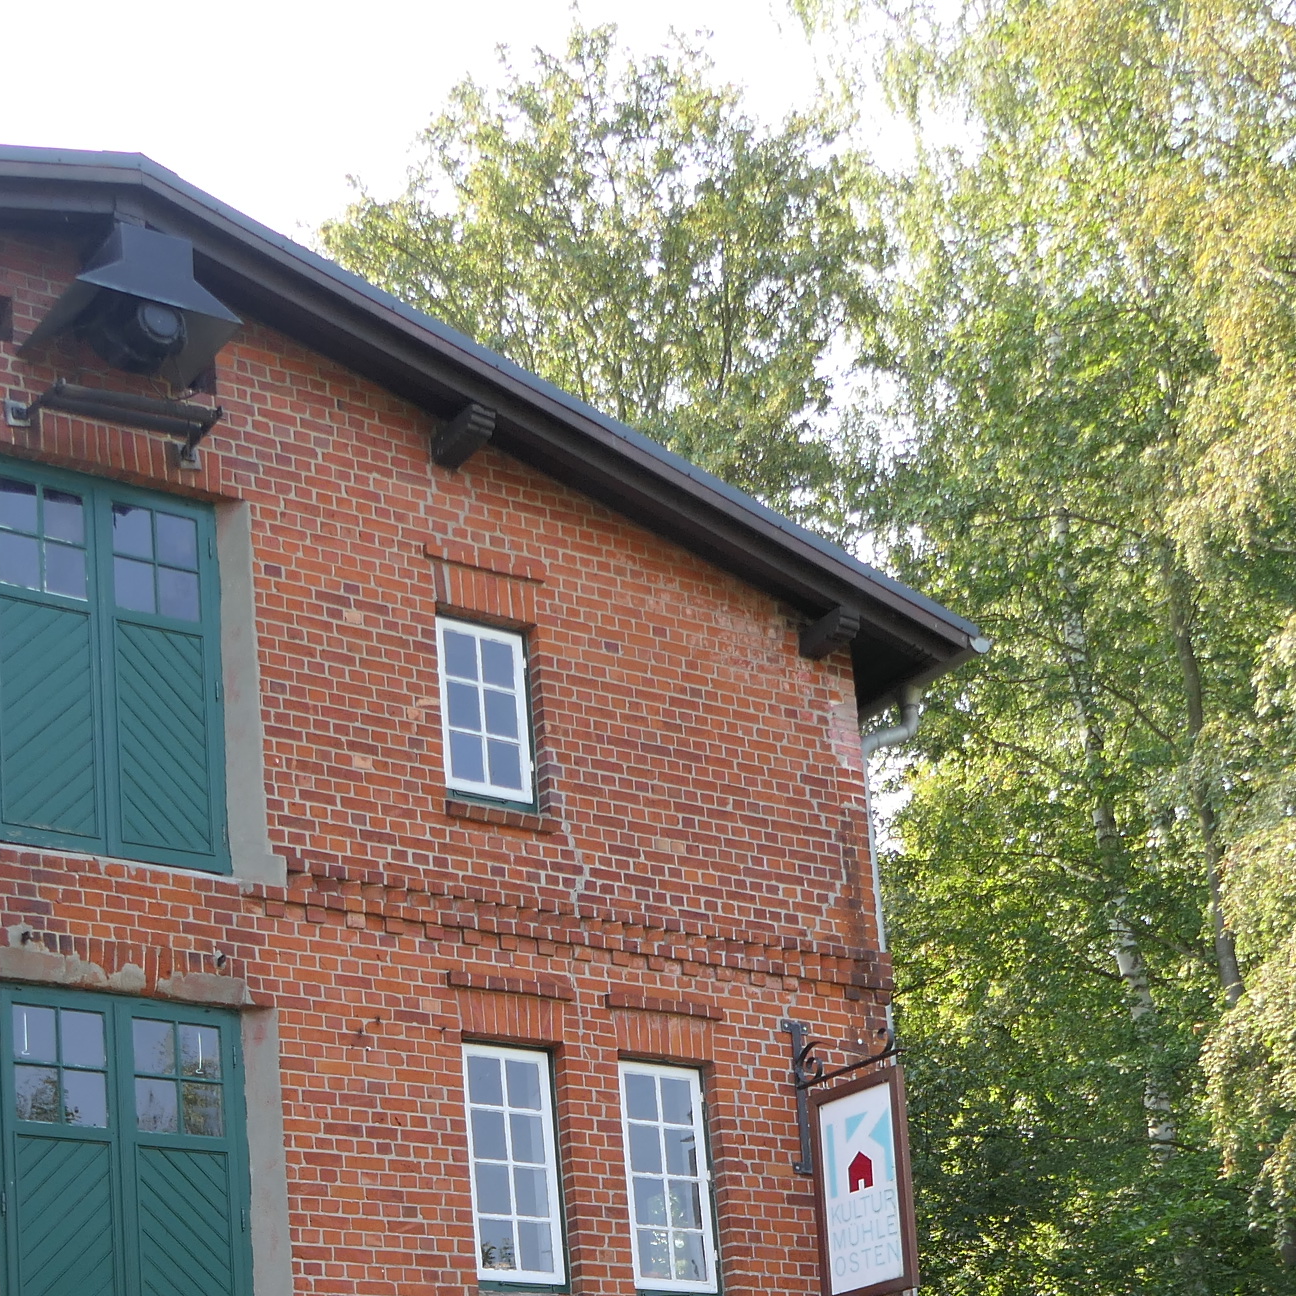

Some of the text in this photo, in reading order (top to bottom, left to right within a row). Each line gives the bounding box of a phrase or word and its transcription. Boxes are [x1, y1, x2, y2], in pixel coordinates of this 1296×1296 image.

[831, 1188, 896, 1227] KULTUR
[833, 1214, 898, 1252] MÜHLE
[835, 1240, 901, 1277] OSTEN
